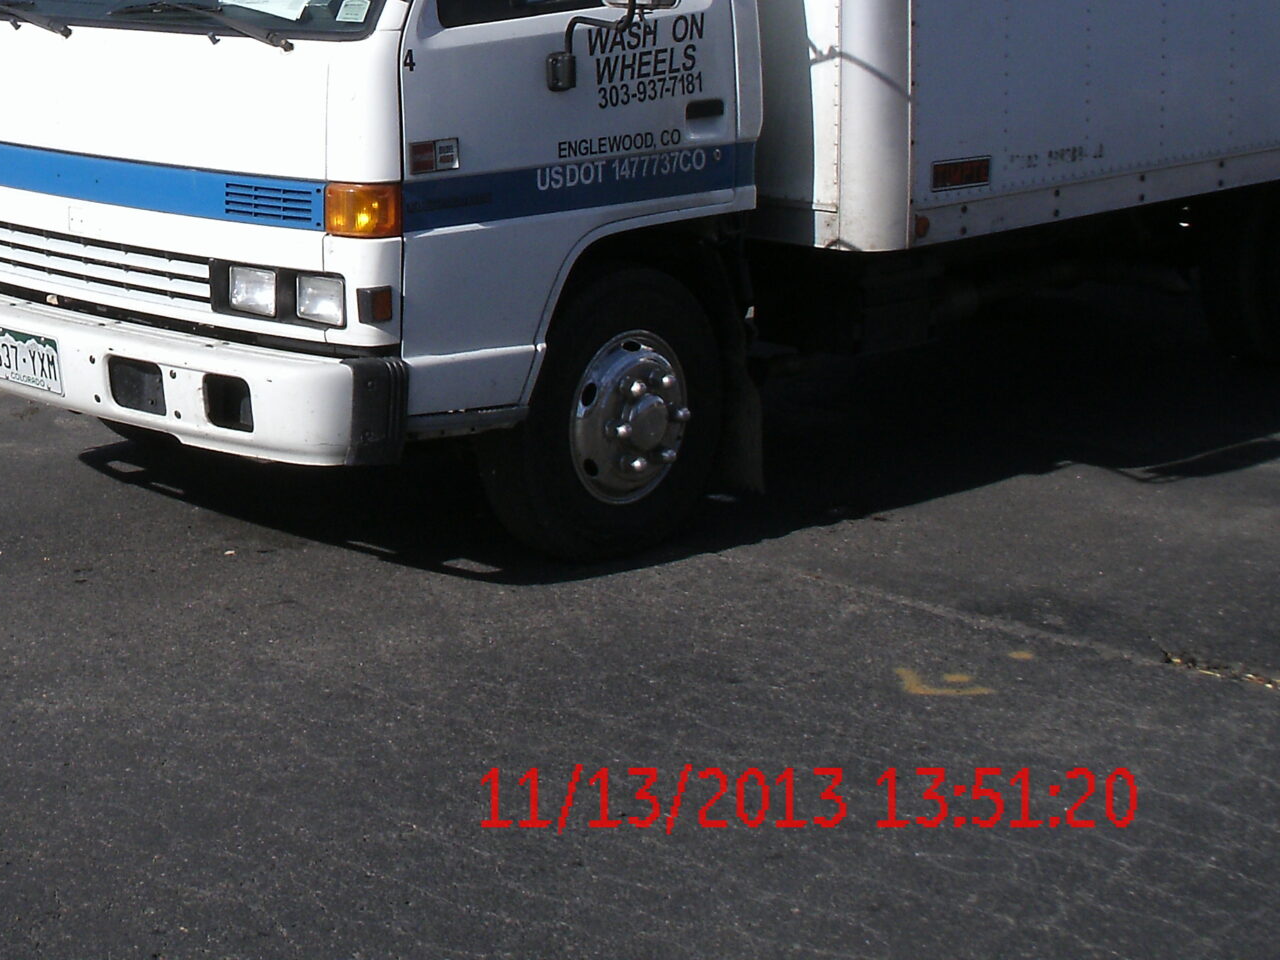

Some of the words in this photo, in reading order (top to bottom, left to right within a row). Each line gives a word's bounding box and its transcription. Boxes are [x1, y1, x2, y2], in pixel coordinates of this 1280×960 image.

[588, 19, 658, 56] WASH
[671, 12, 705, 43] ON
[403, 49, 416, 72] 4
[595, 43, 697, 86] WHEELS
[598, 71, 703, 110] 303-937-7181
[558, 134, 657, 159] ENGLEWOOD,
[660, 128, 682, 146] CO
[537, 160, 606, 191] USDOT
[611, 148, 707, 182] 1477737CO
[10, 371, 46, 388] COLORADO
